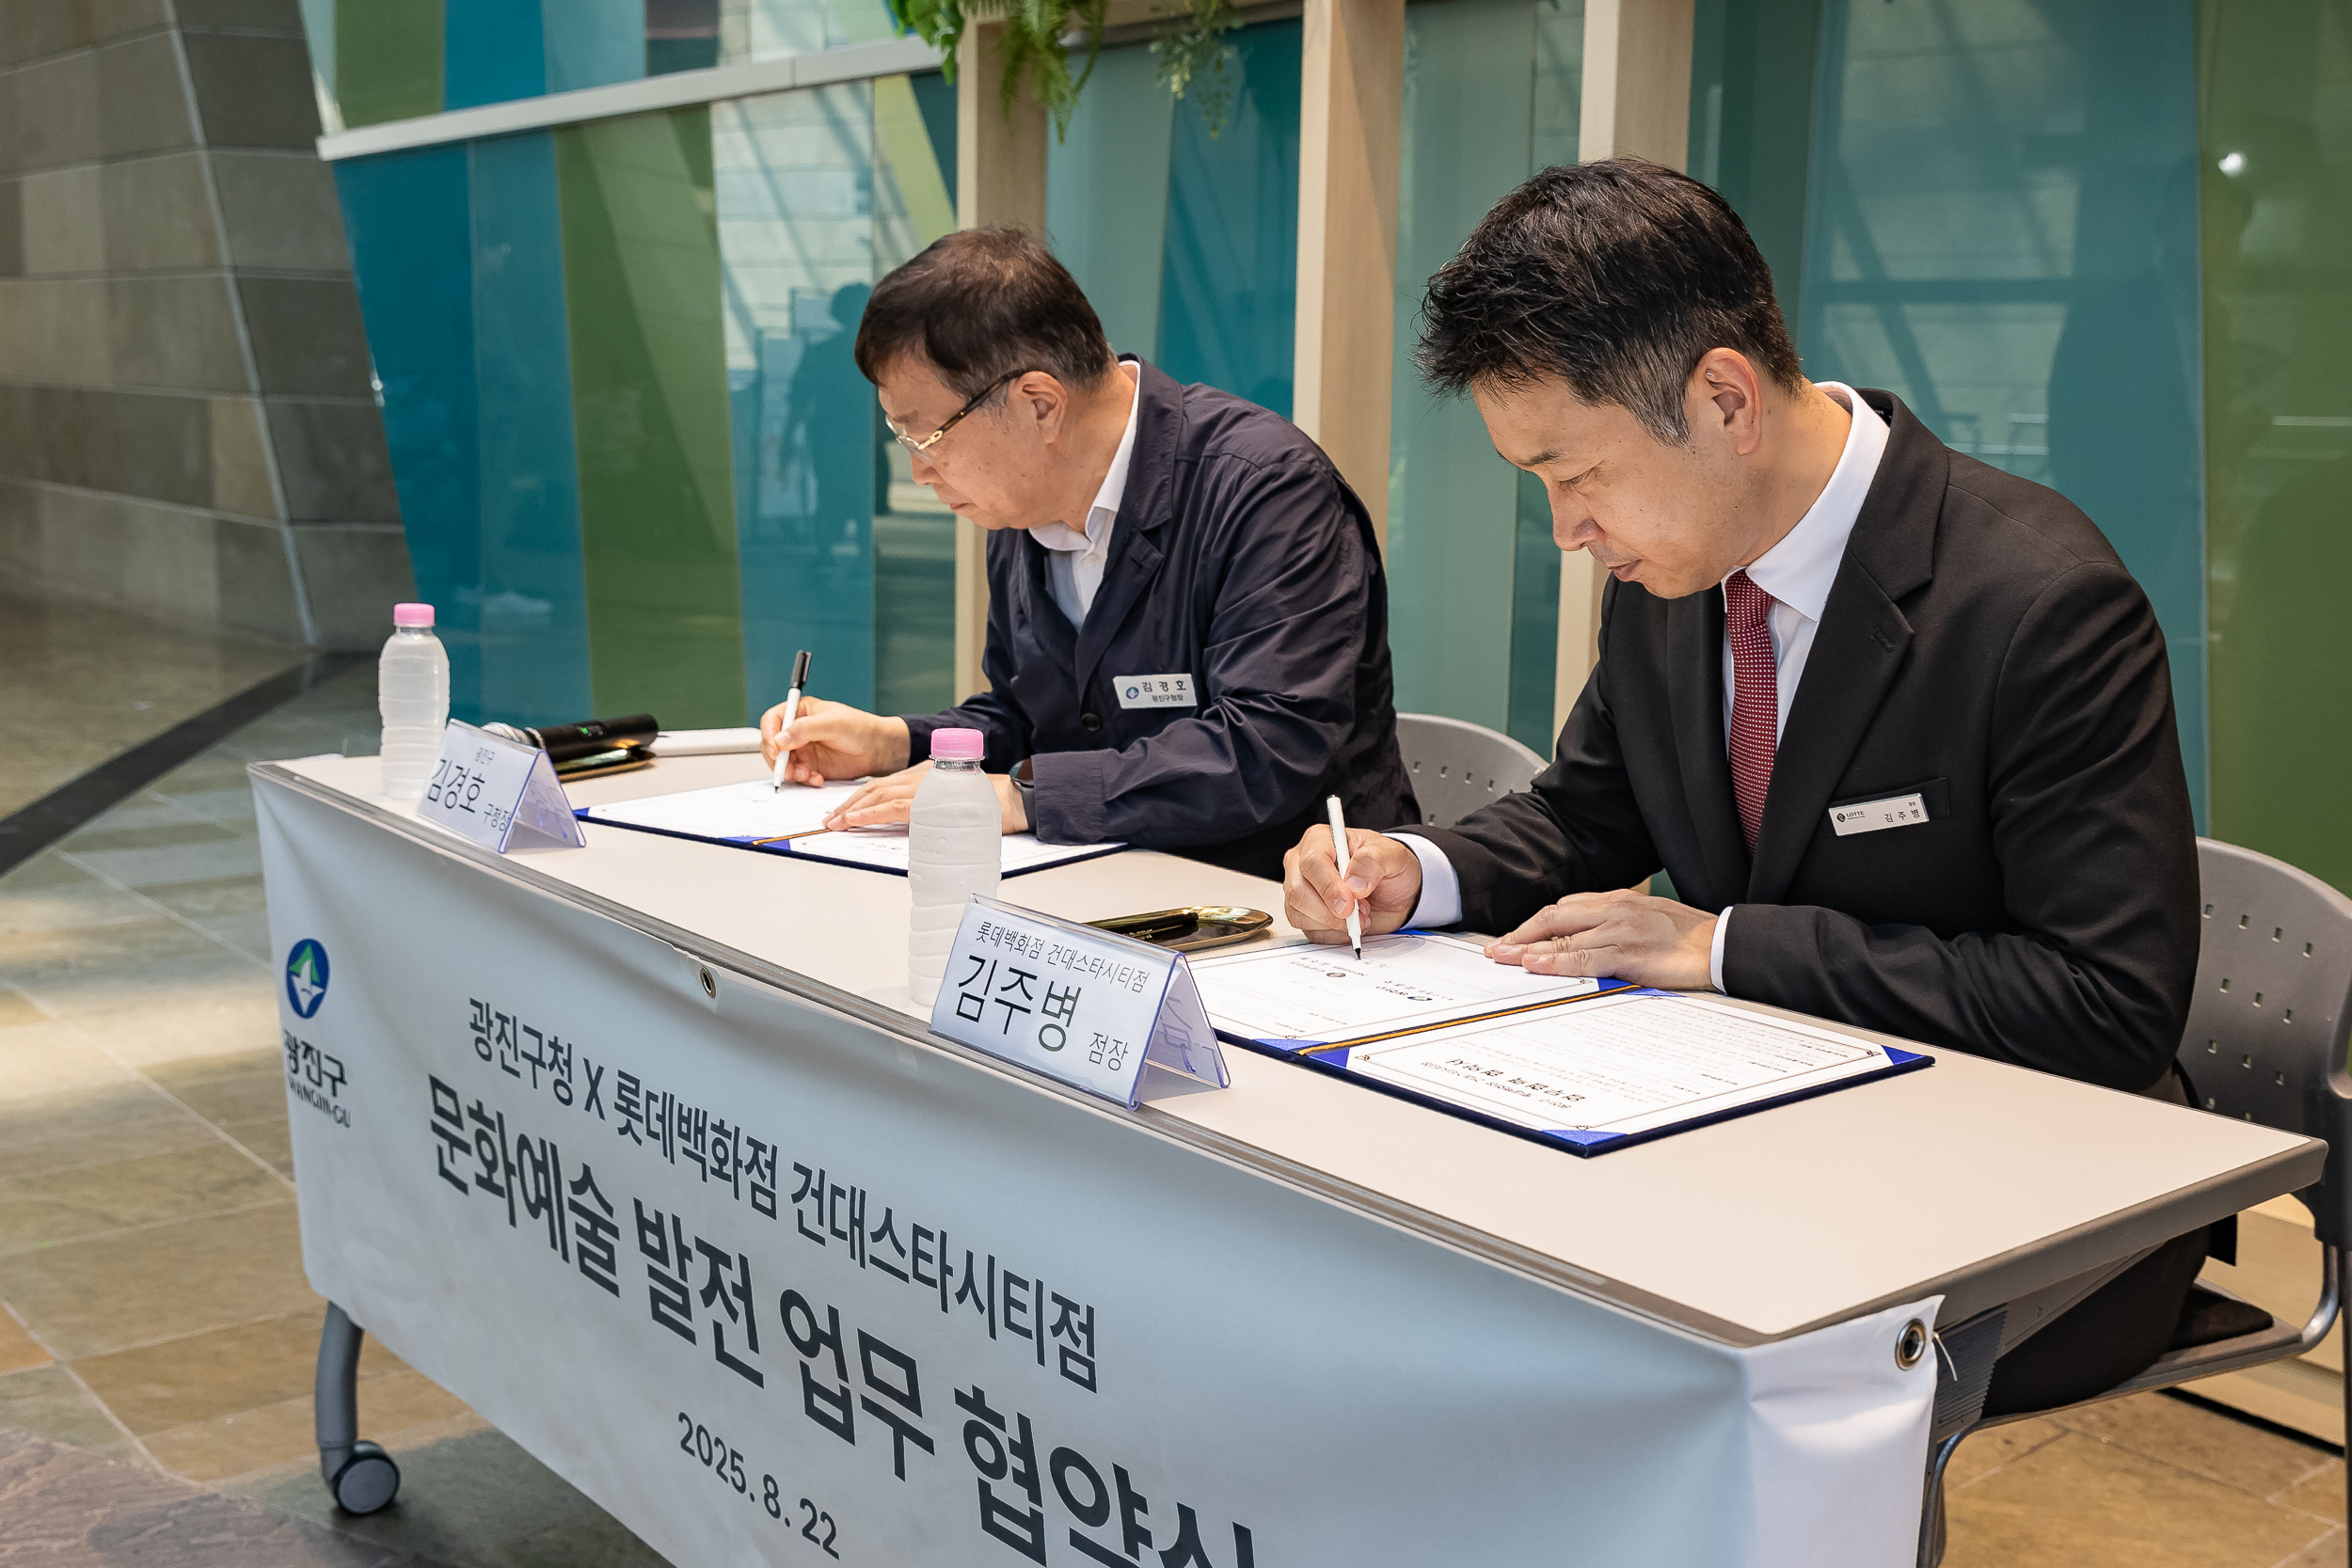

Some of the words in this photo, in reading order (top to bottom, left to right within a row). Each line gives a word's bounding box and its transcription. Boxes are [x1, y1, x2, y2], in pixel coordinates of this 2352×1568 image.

[427, 757, 486, 815] 김경호
[484, 803, 513, 832] 구청장
[1845, 810, 1865, 818] LOTTE
[1883, 808, 1920, 823] 김주병
[976, 921, 1045, 958] 롯데백화점
[1047, 943, 1151, 993] 건대스타시티점
[956, 954, 1082, 1052] 김주병
[283, 1026, 348, 1098] 광진구
[1089, 1031, 1128, 1071] 점장
[469, 997, 574, 1107] 광진구청
[582, 1056, 606, 1120] X
[612, 1069, 778, 1221] 롯데백화점
[790, 1161, 1098, 1395] 건대스타시티점
[428, 1073, 621, 1298] 문화예술
[632, 1196, 765, 1389] 발전
[779, 1288, 936, 1483] 업무
